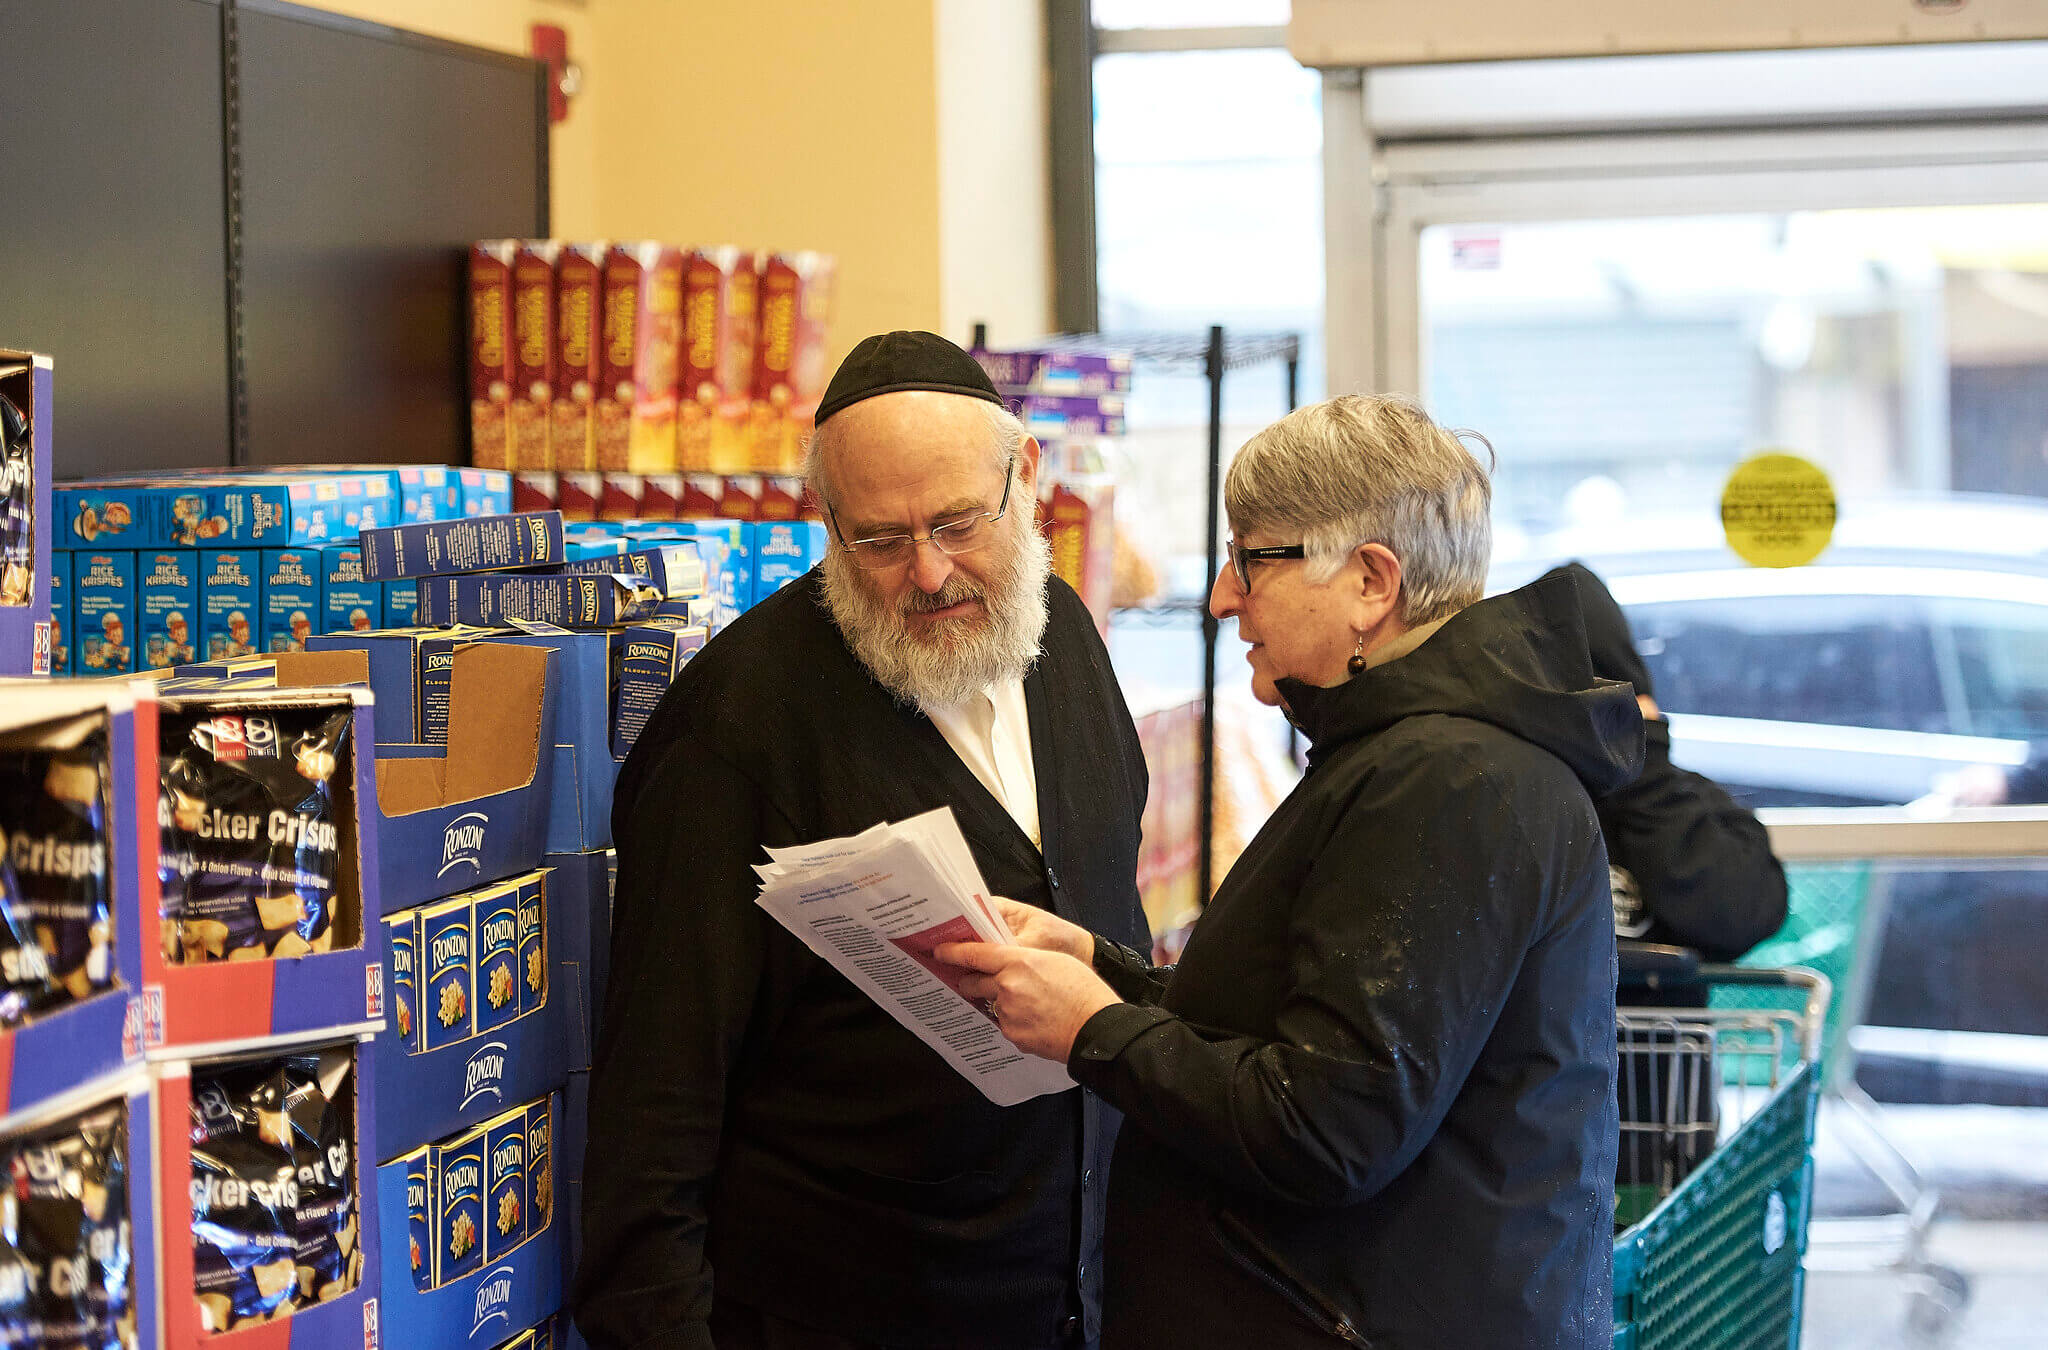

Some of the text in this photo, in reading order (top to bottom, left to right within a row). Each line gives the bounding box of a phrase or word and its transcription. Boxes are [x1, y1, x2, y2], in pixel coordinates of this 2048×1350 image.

[531, 519, 546, 560] RONZONI
[90, 566, 114, 577] RICE
[154, 565, 178, 576] RICE
[216, 564, 241, 575] RICE
[269, 574, 312, 586] KRISPIES
[278, 564, 303, 575] RICE
[81, 575, 123, 588] KRISPIES
[145, 575, 188, 587] KRISPIES
[207, 574, 249, 587] KRISPIES
[582, 580, 595, 622] RONZONI
[628, 644, 668, 660] RONZONI
[267, 809, 337, 852] Crisps
[442, 825, 485, 864] RONZONI
[230, 863, 253, 877] Flavor
[483, 919, 515, 955] RONZONI
[394, 950, 411, 972] ZONI
[433, 935, 468, 972] RONZONI
[464, 1055, 504, 1098] RONZONI
[494, 1145, 522, 1182] RONZONI
[445, 1166, 478, 1204] RONZONI
[408, 1186, 424, 1207] ZONI
[473, 1280, 511, 1325] RONZONI
